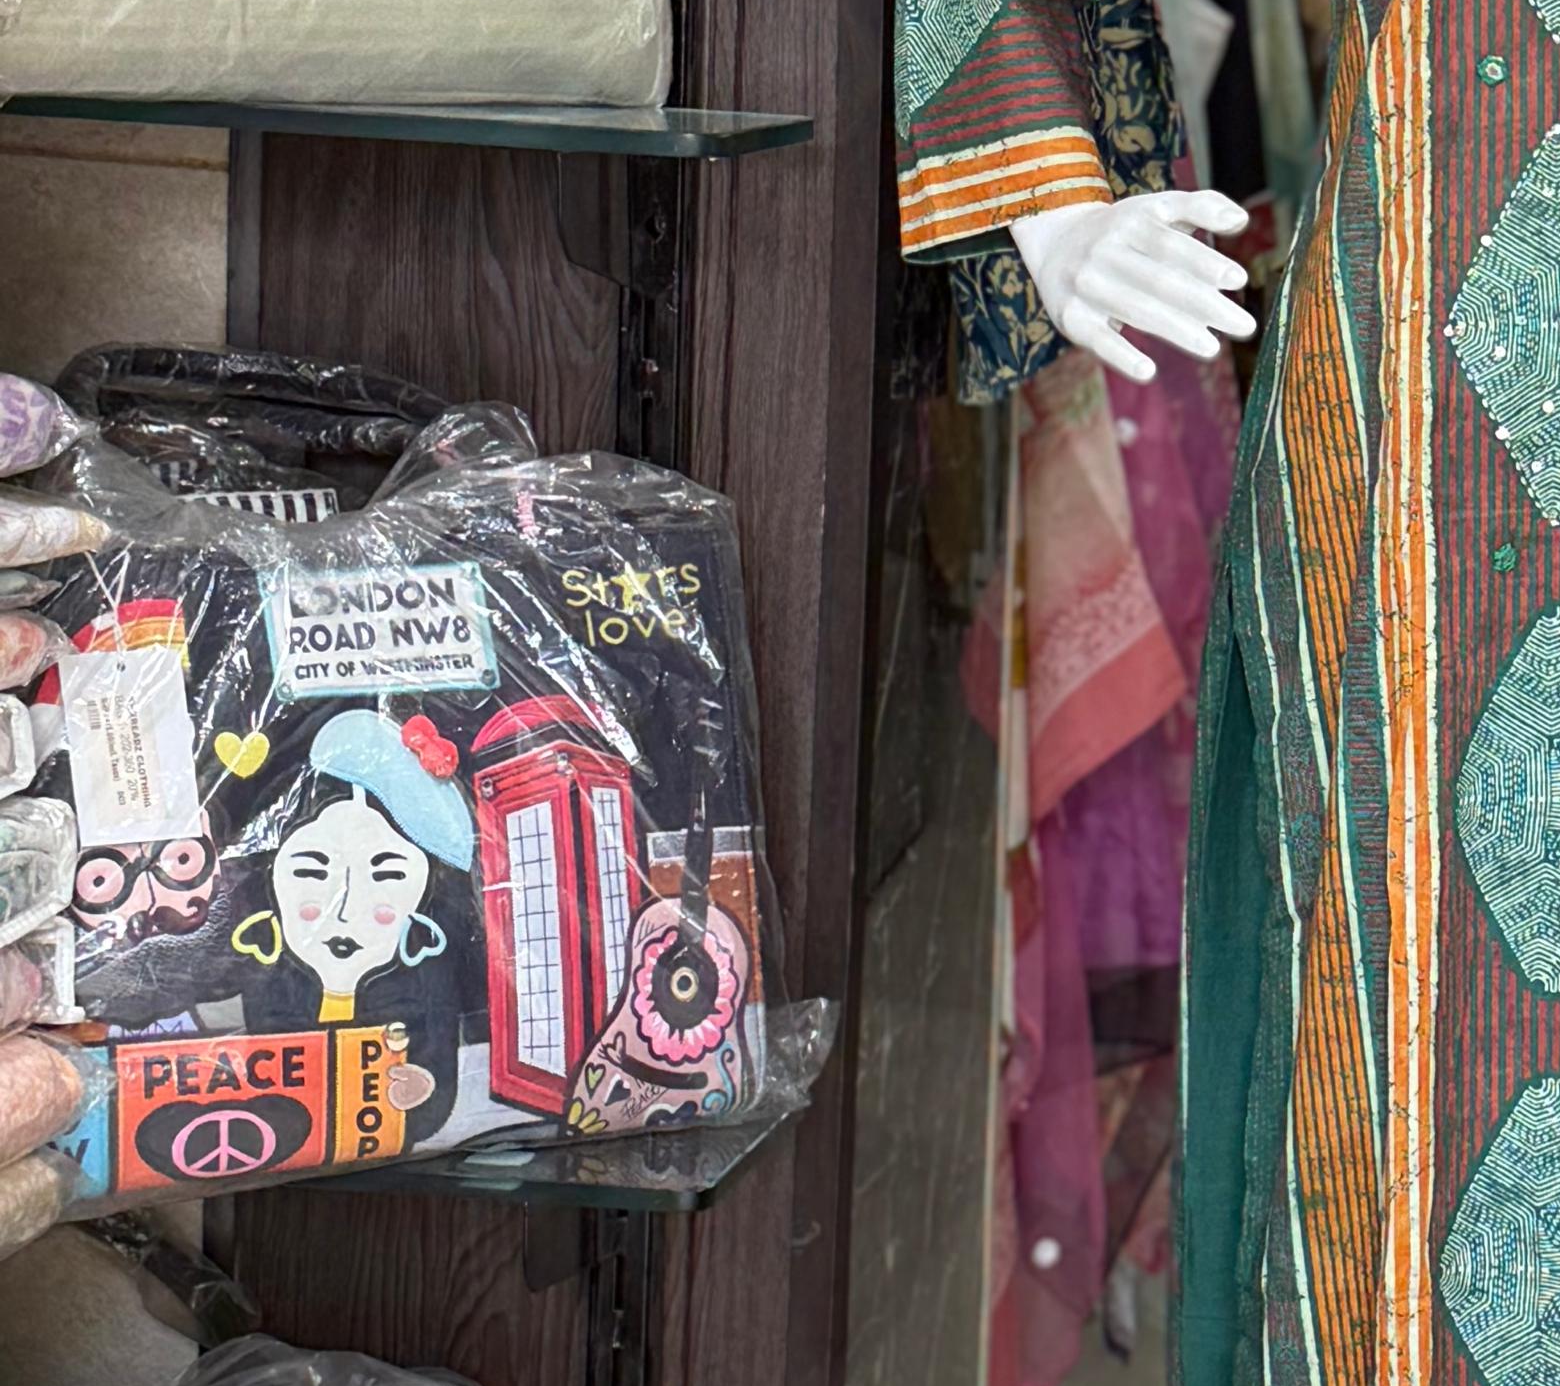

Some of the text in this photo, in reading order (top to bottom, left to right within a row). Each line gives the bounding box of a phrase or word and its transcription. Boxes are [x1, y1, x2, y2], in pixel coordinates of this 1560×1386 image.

[289, 578, 456, 618] LONDON
[289, 615, 471, 655] ROAD NW8
[585, 608, 687, 647] love
[295, 653, 475, 679] CITY OF WTMINSTER
[136, 755, 152, 808] CLOTHING
[143, 1046, 306, 1099] PEACE
